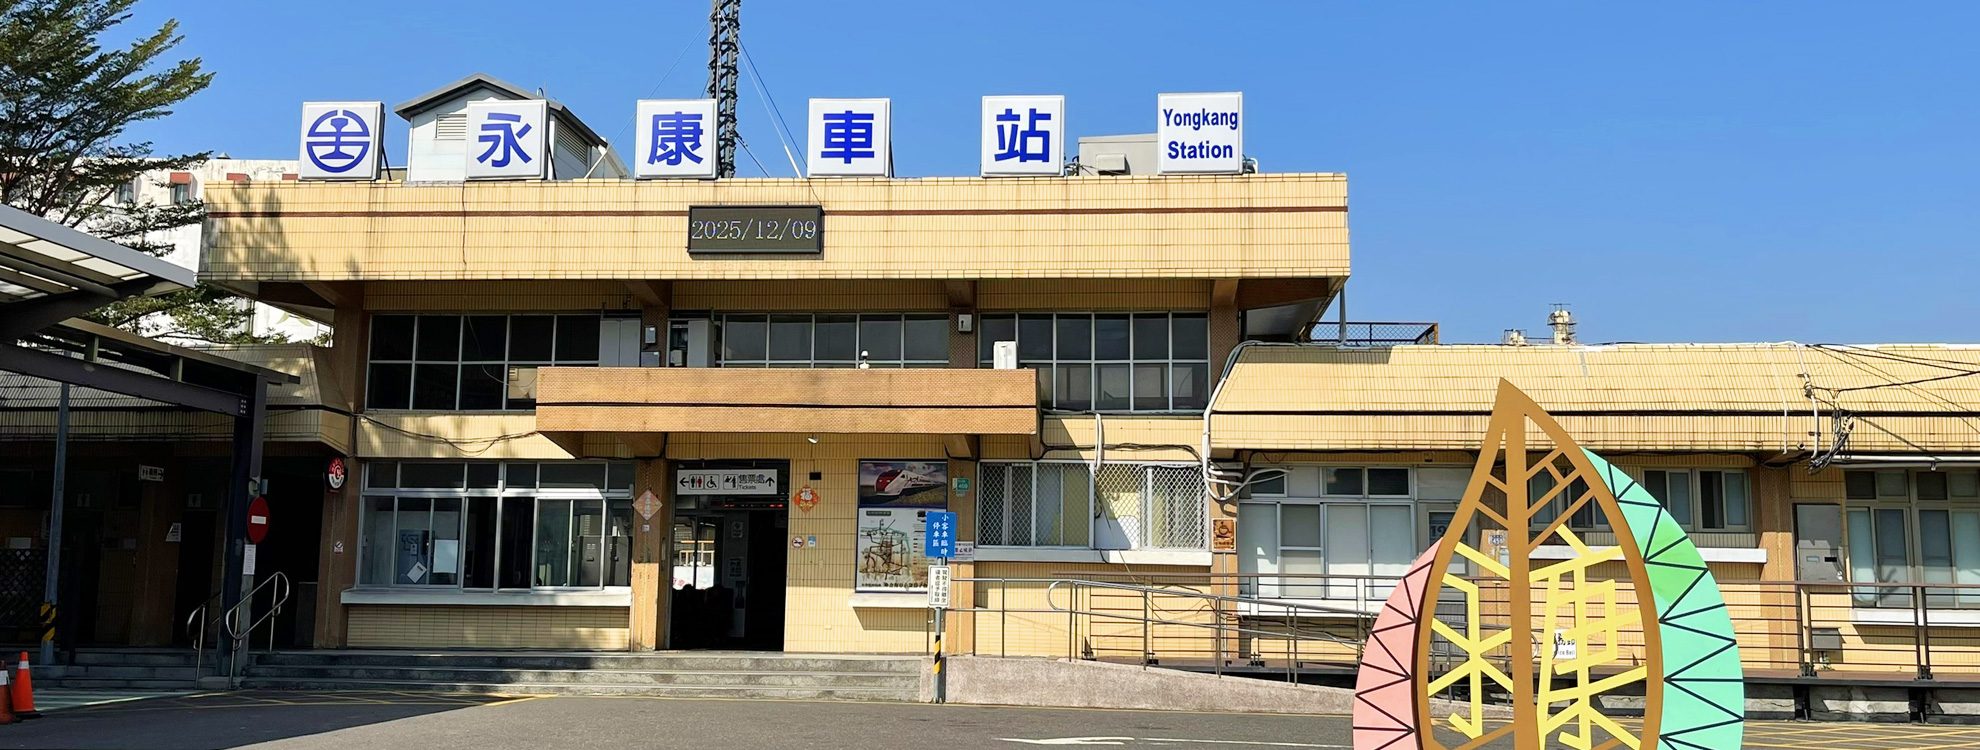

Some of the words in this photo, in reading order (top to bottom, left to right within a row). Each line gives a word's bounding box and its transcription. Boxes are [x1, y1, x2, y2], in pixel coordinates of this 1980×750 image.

[1163, 108, 1238, 131] Yongkang
[477, 108, 1051, 168] 永康車站
[1168, 141, 1233, 159] Station
[691, 218, 816, 240] 2025/12/09
[800, 488, 813, 501] 福
[932, 521, 940, 547] 停車區
[940, 514, 949, 556] 小客車臨時
